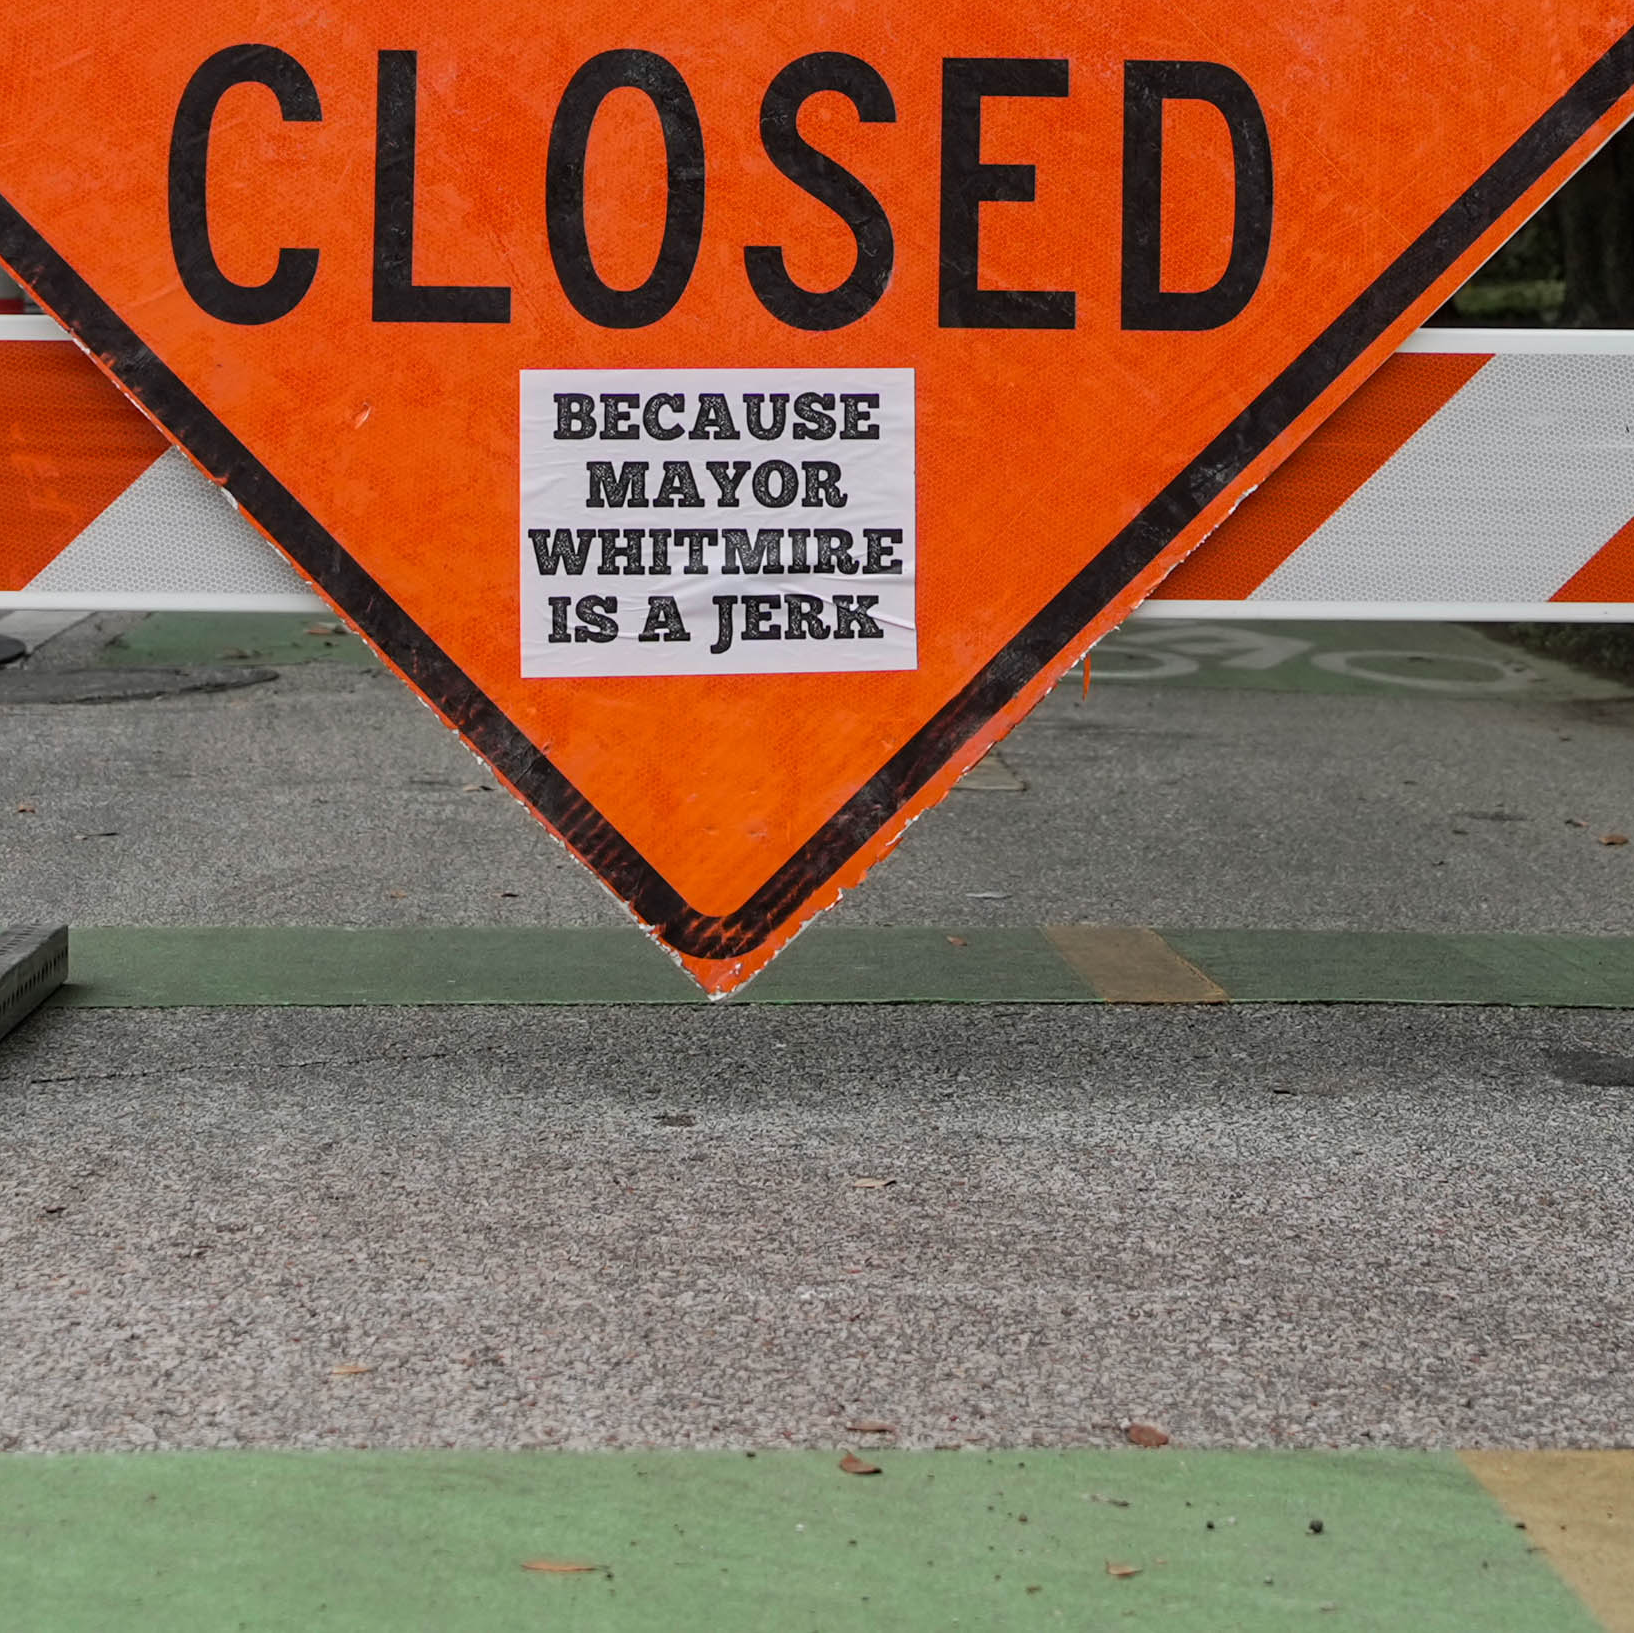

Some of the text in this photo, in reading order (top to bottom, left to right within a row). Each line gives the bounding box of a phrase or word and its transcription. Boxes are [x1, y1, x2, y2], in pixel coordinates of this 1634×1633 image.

[168, 43, 1274, 332] CLOSED
[553, 392, 880, 441] BECAUSE
[586, 459, 848, 508] MAYOR
[527, 528, 903, 576] WHITMIRE
[548, 594, 884, 655] IS A JERK
